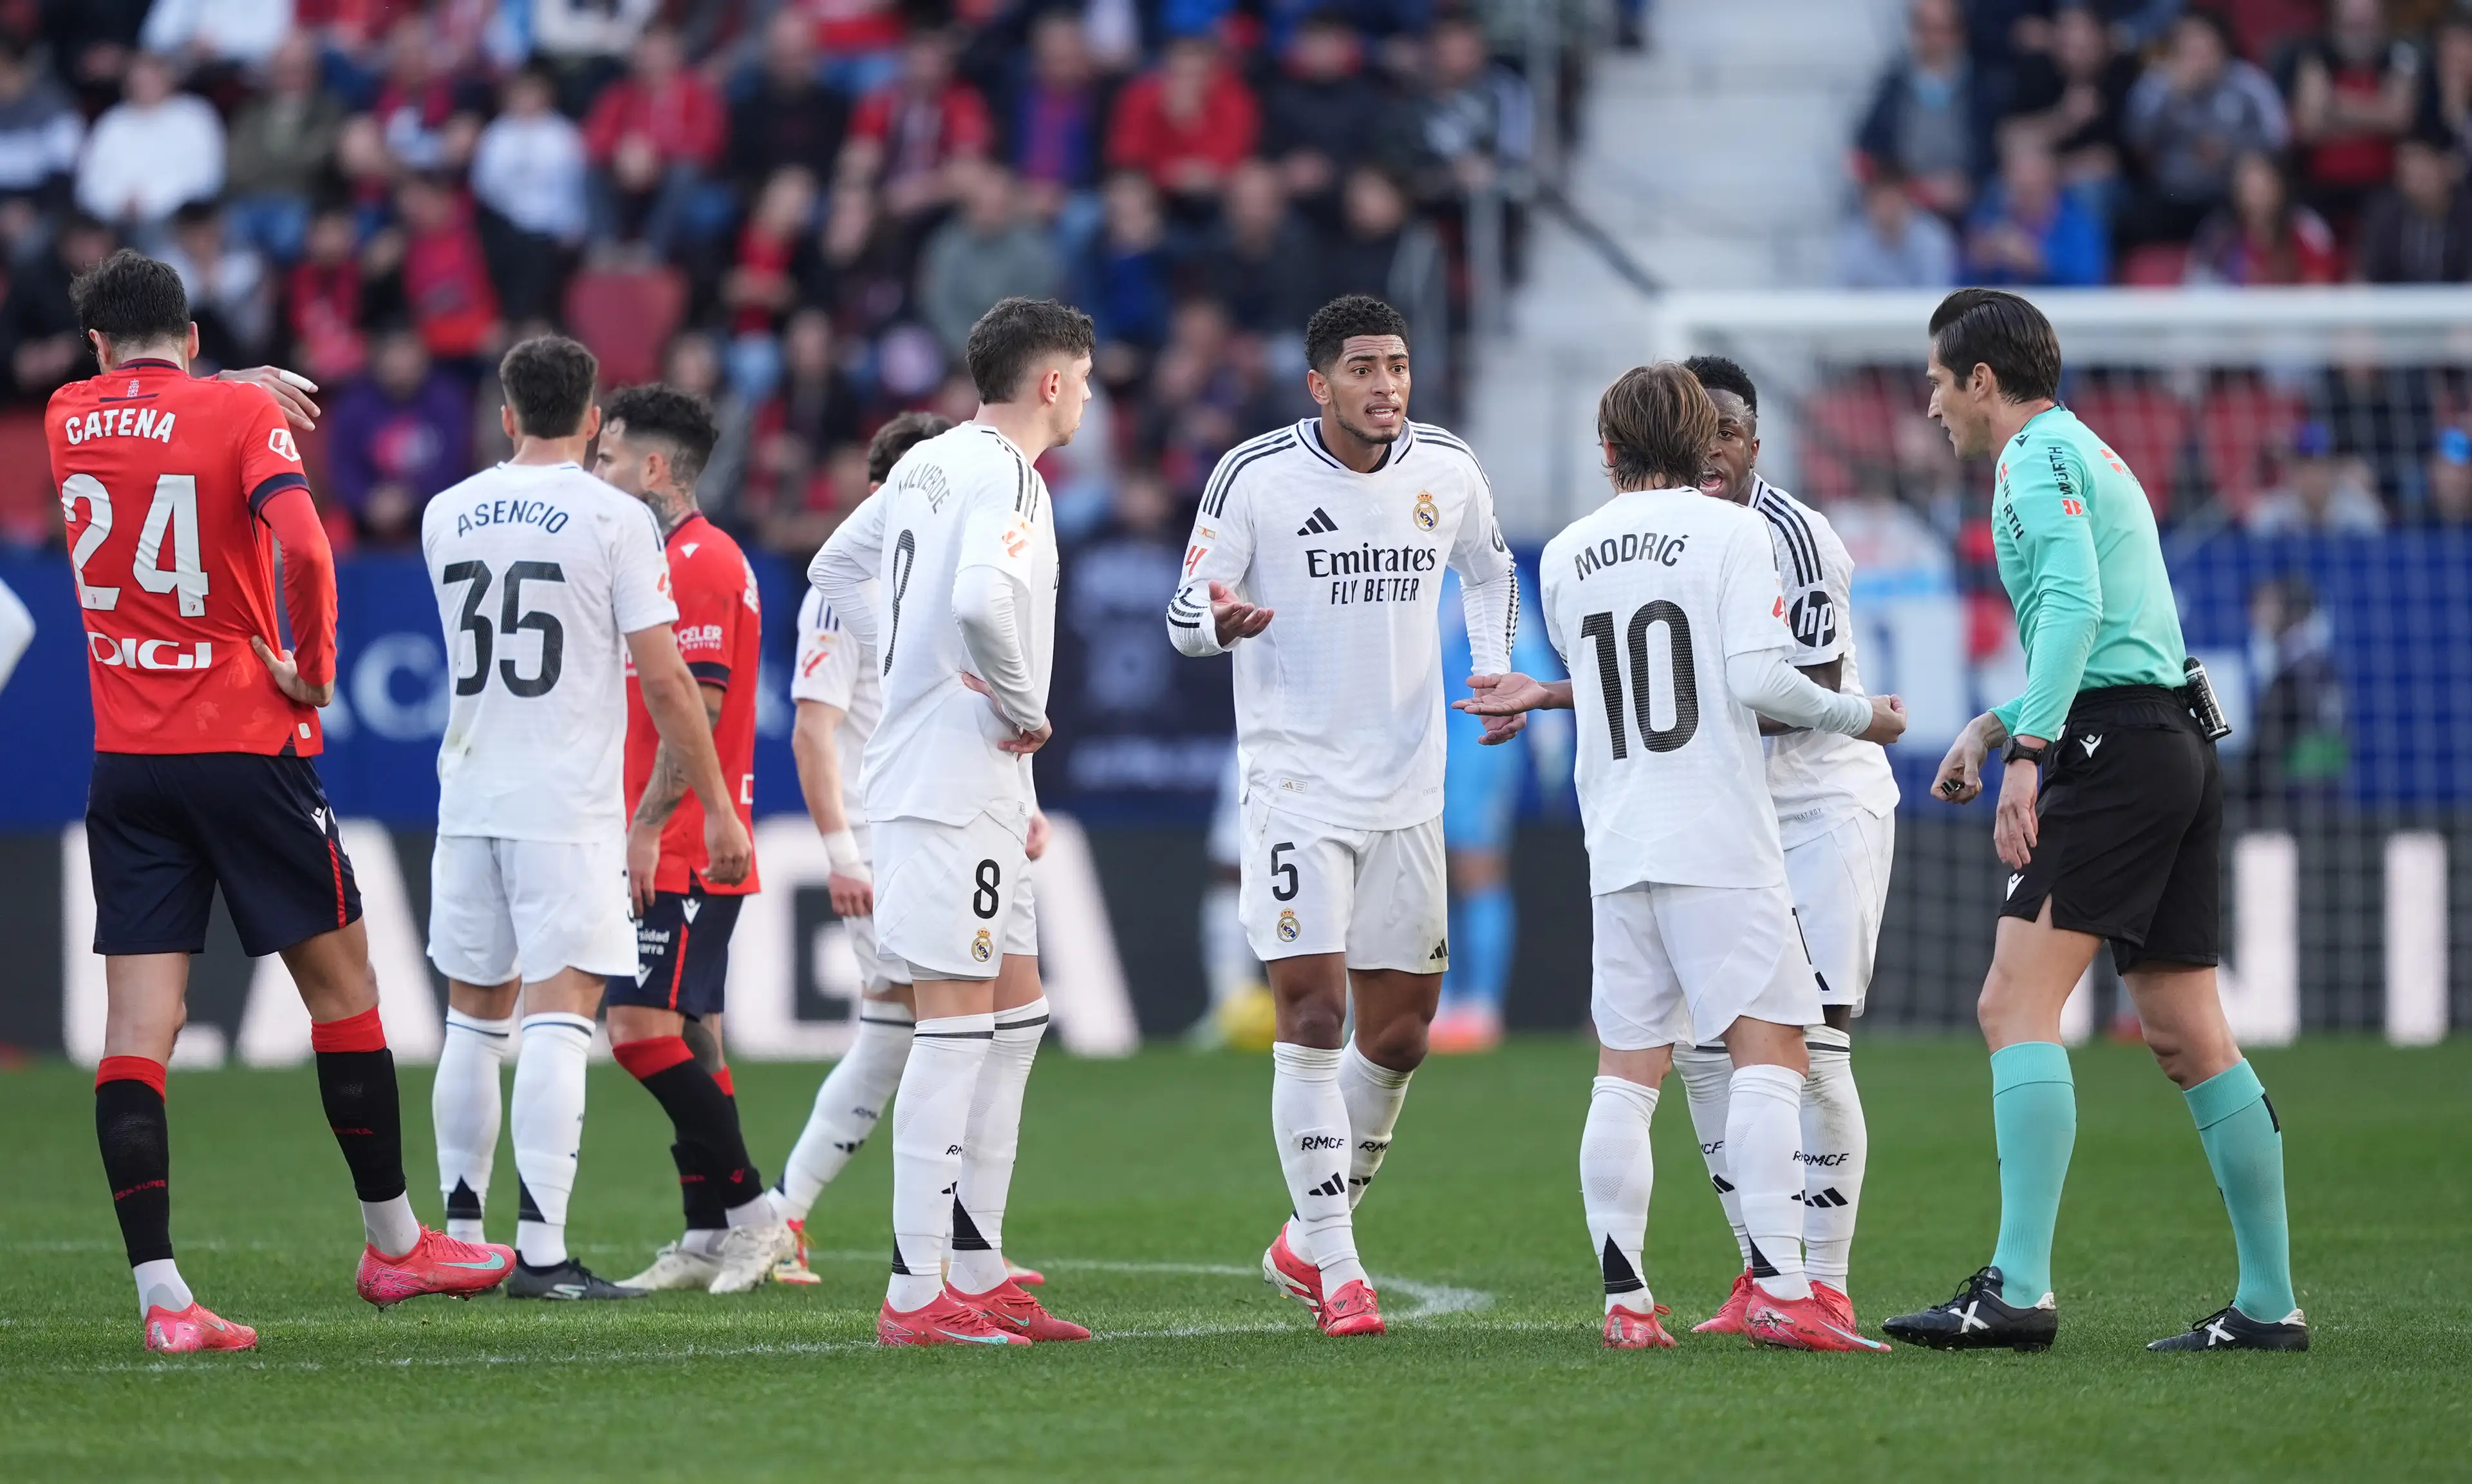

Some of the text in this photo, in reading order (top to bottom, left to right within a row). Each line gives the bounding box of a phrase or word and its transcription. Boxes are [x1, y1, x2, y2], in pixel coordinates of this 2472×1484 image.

[66, 408, 176, 445] CATENA
[2048, 447, 2072, 495] WÜRTH
[457, 499, 568, 537] ASENCIO
[2003, 479, 2025, 540] WRTH
[61, 473, 209, 617] 24
[1305, 542, 1437, 578] Emirates
[1574, 533, 1690, 581] MODRIĆ
[1331, 578, 1419, 605] FLY BETTER
[443, 560, 565, 698] 35
[1798, 598, 1834, 647] hp
[87, 631, 212, 669] DIGI
[1581, 599, 1700, 761] 10
[973, 858, 1000, 919] 8
[1271, 842, 1299, 901] 5
[62, 816, 1141, 1067] LAGA
[1300, 1135, 1345, 1151] RMCF
[1701, 1140, 1724, 1155] CF
